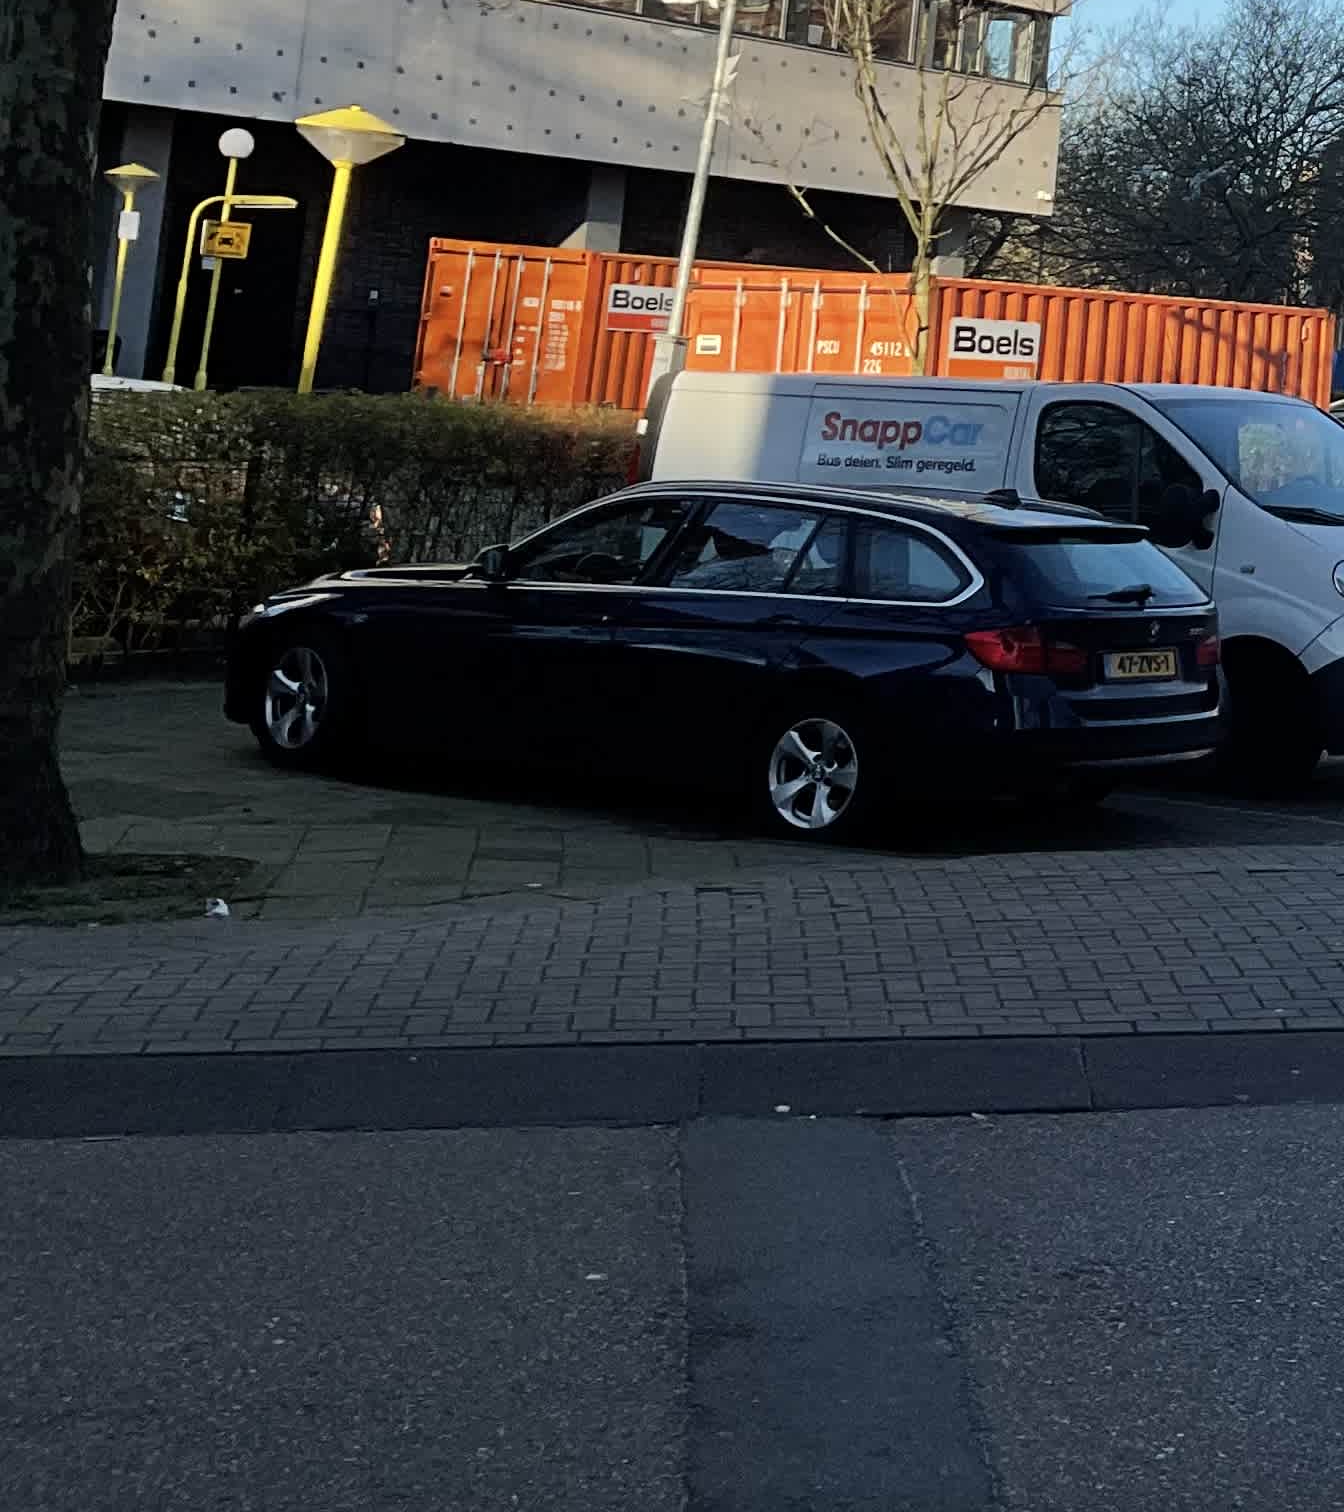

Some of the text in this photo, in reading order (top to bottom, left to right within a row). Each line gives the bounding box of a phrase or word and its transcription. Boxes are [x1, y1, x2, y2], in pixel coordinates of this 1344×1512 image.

[611, 289, 673, 312] Boels
[953, 326, 1035, 357] Boels
[821, 411, 985, 450] SnappCar
[817, 453, 841, 467] Bus
[885, 455, 914, 470] Slim
[916, 458, 977, 474] geregeld.
